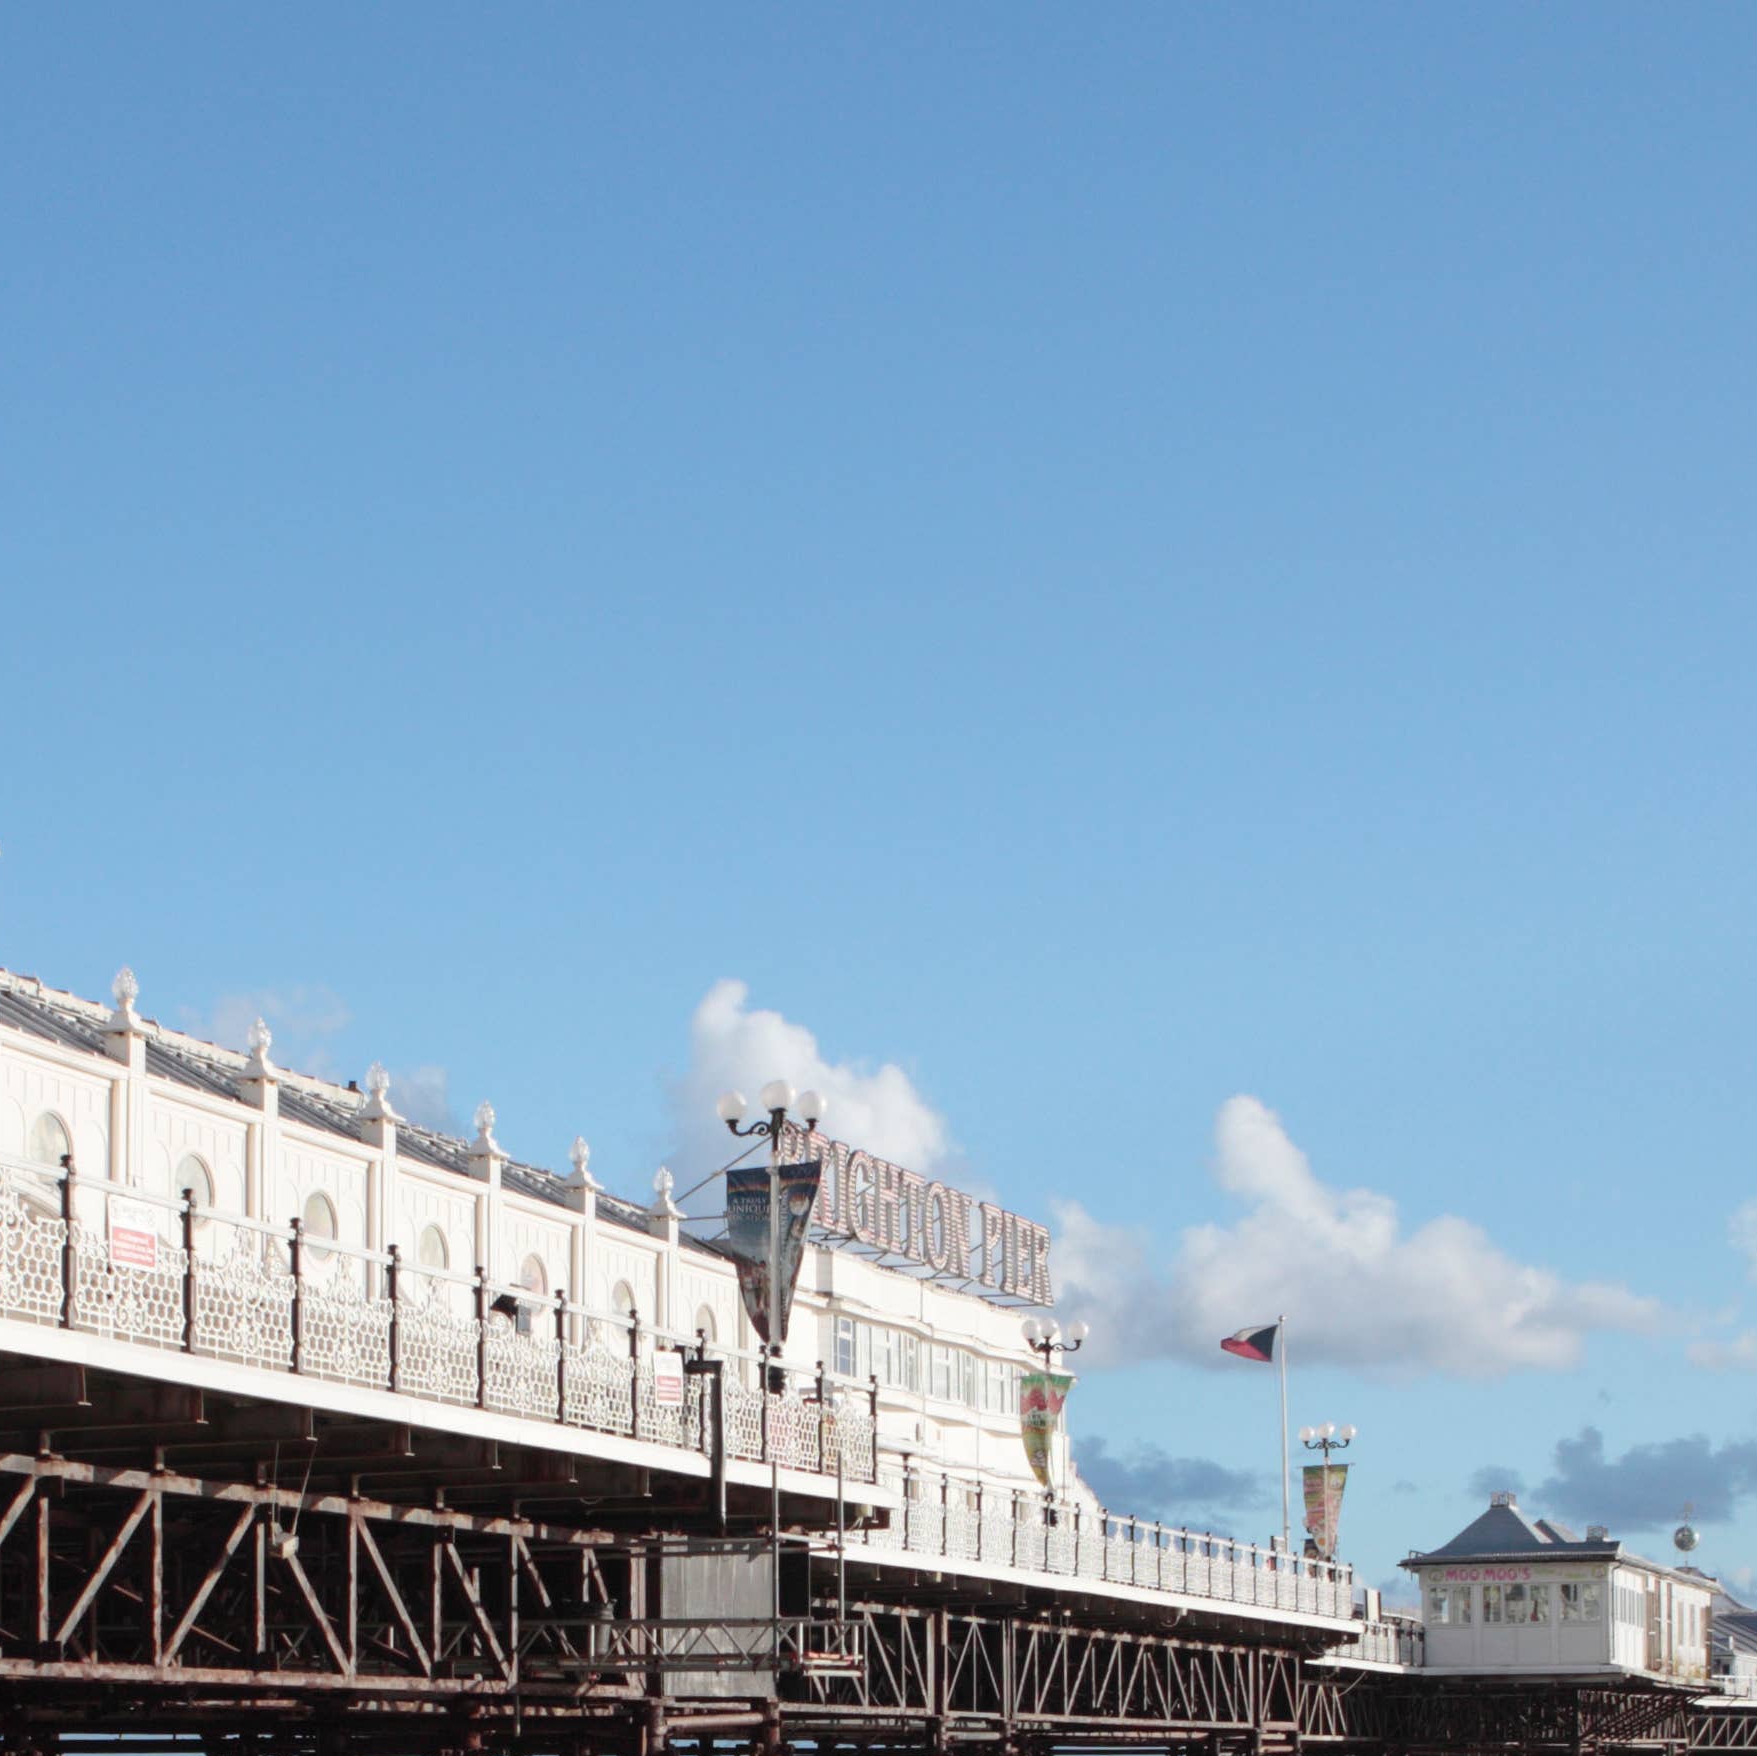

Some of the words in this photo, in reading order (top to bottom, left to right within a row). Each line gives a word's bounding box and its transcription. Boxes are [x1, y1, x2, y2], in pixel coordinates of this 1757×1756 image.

[979, 1202, 1054, 1307] PIER
[1445, 1568, 1479, 1582] MOO
[1483, 1567, 1532, 1581] MOO'S
